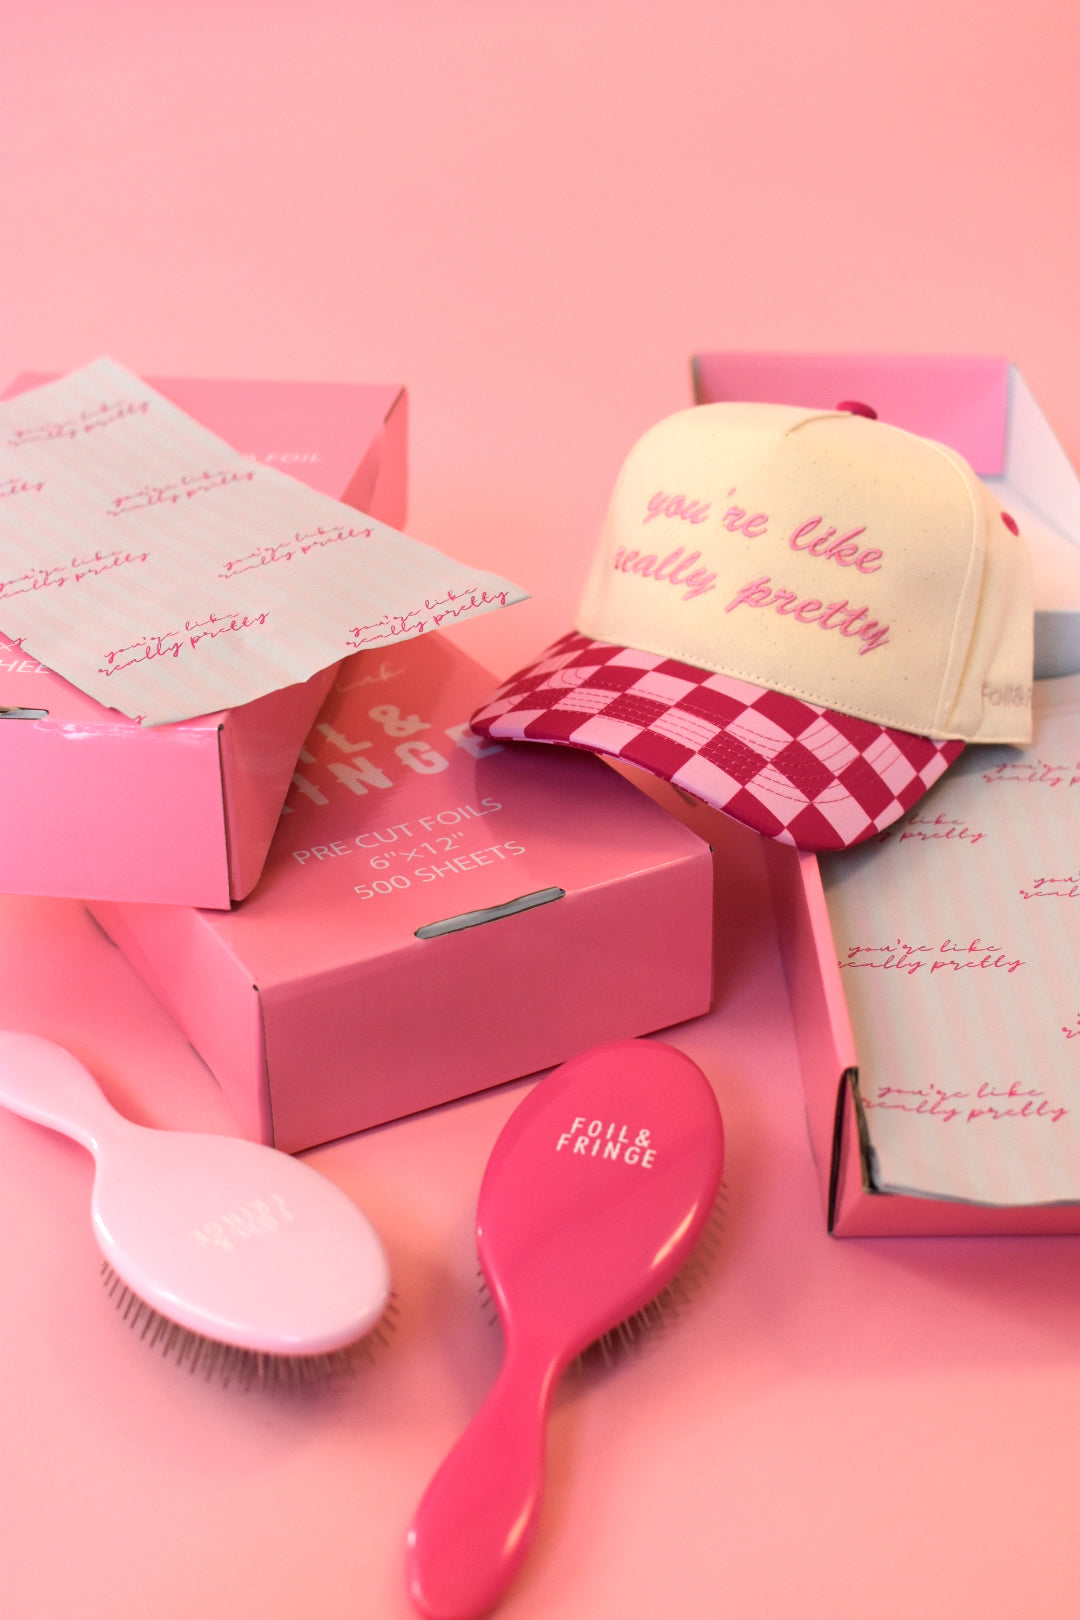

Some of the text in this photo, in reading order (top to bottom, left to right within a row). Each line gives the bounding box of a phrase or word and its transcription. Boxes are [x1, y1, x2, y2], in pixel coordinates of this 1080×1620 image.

[218, 528, 374, 579] really pretty
[295, 526, 345, 542] like
[643, 487, 884, 574] you're like
[0, 552, 151, 600] eally pretty
[71, 551, 126, 568] like
[345, 591, 509, 648] really pretty
[348, 586, 478, 637] you're like
[613, 546, 890, 656] really pretty
[97, 612, 270, 676] really pretty
[103, 612, 240, 664] you're like
[292, 796, 503, 865] PRE CUT FOILS
[899, 827, 989, 844] pretty
[906, 812, 966, 826] like
[353, 840, 526, 901] 500 SHEETS
[848, 937, 1003, 959] you're like
[930, 954, 1028, 974] pretty
[860, 1097, 1072, 1123] really pretty
[877, 1080, 1046, 1101] you're like
[556, 1133, 658, 1169] FRINGE
